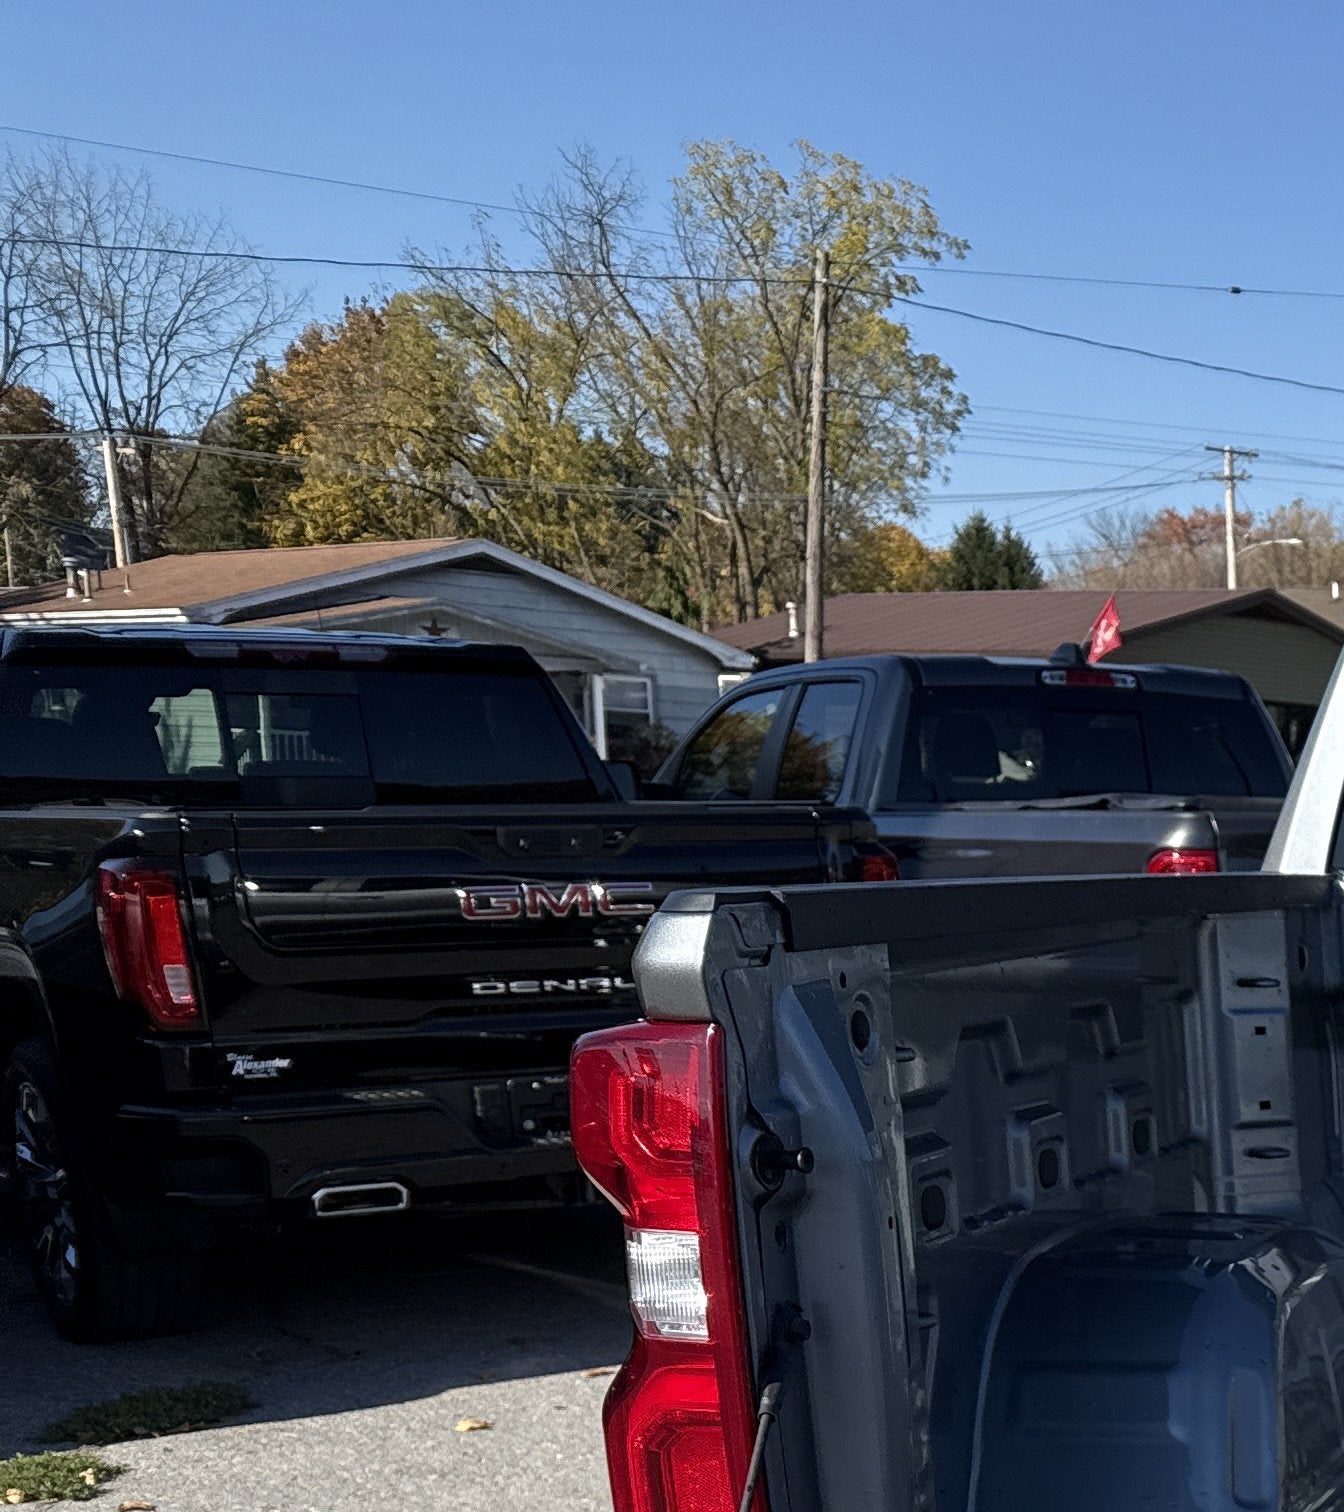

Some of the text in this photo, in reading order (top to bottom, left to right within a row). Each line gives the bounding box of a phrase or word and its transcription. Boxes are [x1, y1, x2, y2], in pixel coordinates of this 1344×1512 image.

[458, 882, 655, 920] GMC
[472, 977, 636, 995] DENAL
[231, 1058, 291, 1075] Alexander
